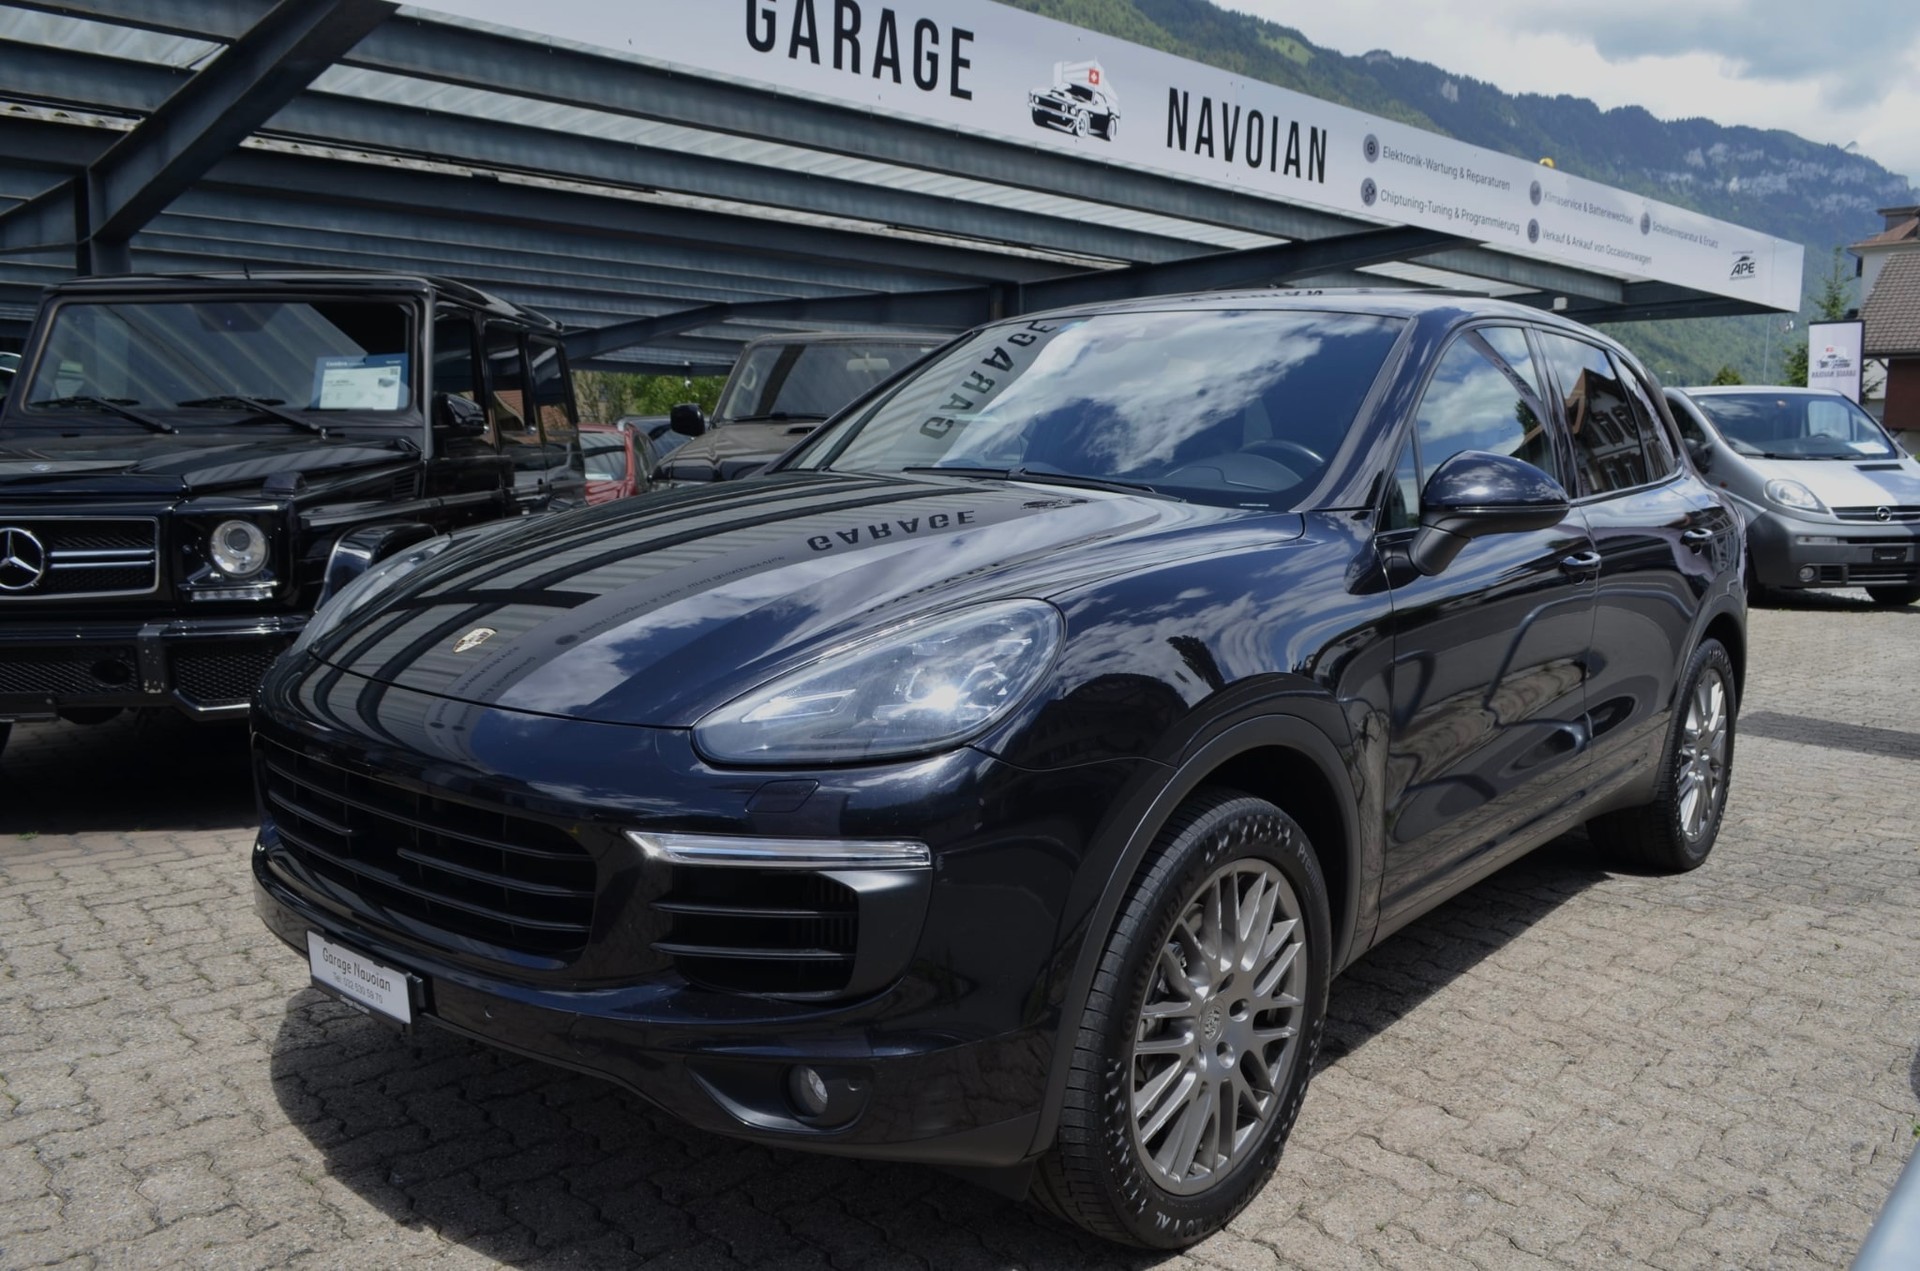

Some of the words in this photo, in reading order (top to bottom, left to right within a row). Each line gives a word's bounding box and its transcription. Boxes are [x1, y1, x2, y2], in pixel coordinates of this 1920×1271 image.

[746, 0, 975, 101] GARAGE
[1167, 86, 1328, 185] NAVOIAN
[1382, 145, 1458, 180] Elektronik-Wartung
[1459, 166, 1465, 179] &
[1466, 168, 1511, 191] Reparaturen
[1380, 188, 1453, 220] Chiptuning-Tuning
[1454, 207, 1460, 219] &
[1460, 208, 1520, 236] Programmierung
[1542, 228, 1565, 244] Verkauf
[1566, 234, 1571, 245] &
[1571, 236, 1594, 251] Ankauf
[1730, 261, 1756, 277] APE
[322, 947, 352, 975] Garage
